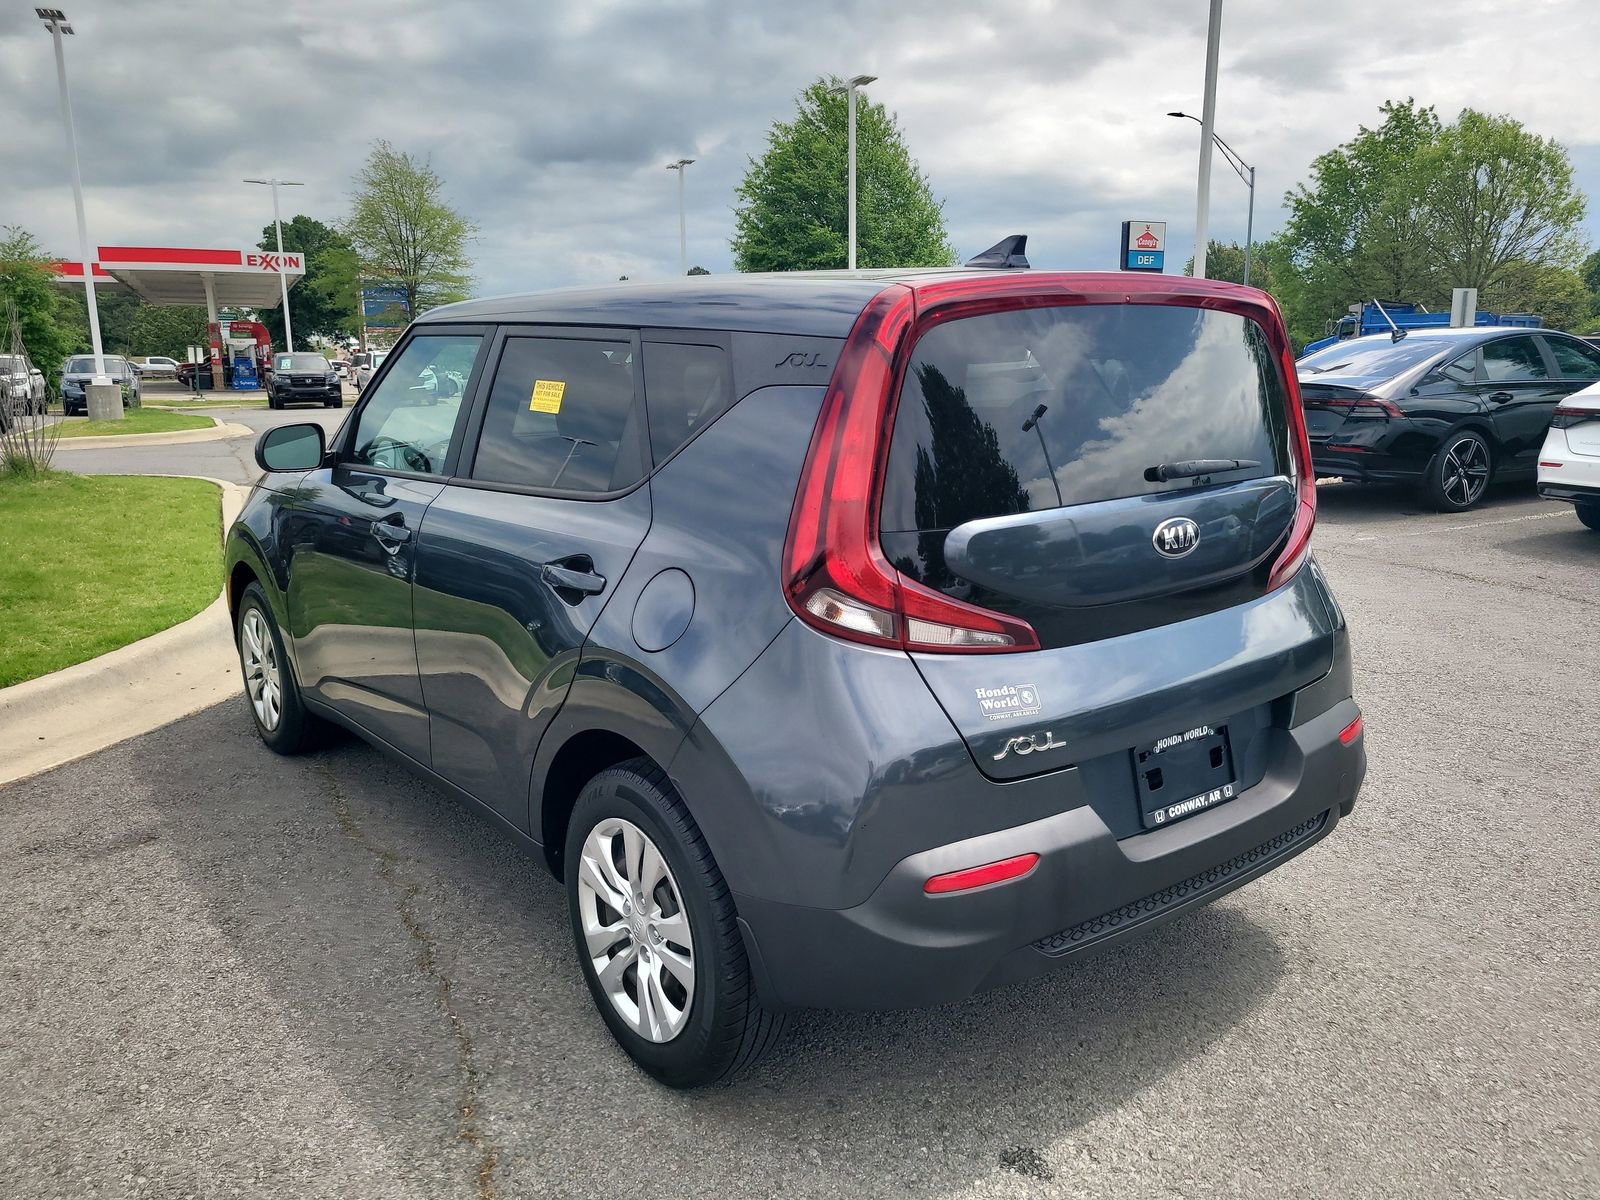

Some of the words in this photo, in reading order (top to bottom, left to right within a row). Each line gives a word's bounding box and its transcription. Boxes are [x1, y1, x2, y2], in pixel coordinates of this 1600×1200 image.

[247, 253, 300, 272] EXXON
[1137, 255, 1155, 265] DEF
[546, 383, 563, 391] VEHICLE
[1162, 524, 1195, 550] KIA
[975, 685, 1017, 699] Honda
[980, 695, 1020, 710] World
[1013, 709, 1039, 718] ARKANSAS
[1157, 734, 1183, 750] HONDA
[1183, 725, 1208, 743] WORLD
[1168, 797, 1208, 818] CONWAY,
[1209, 790, 1221, 804] AR
